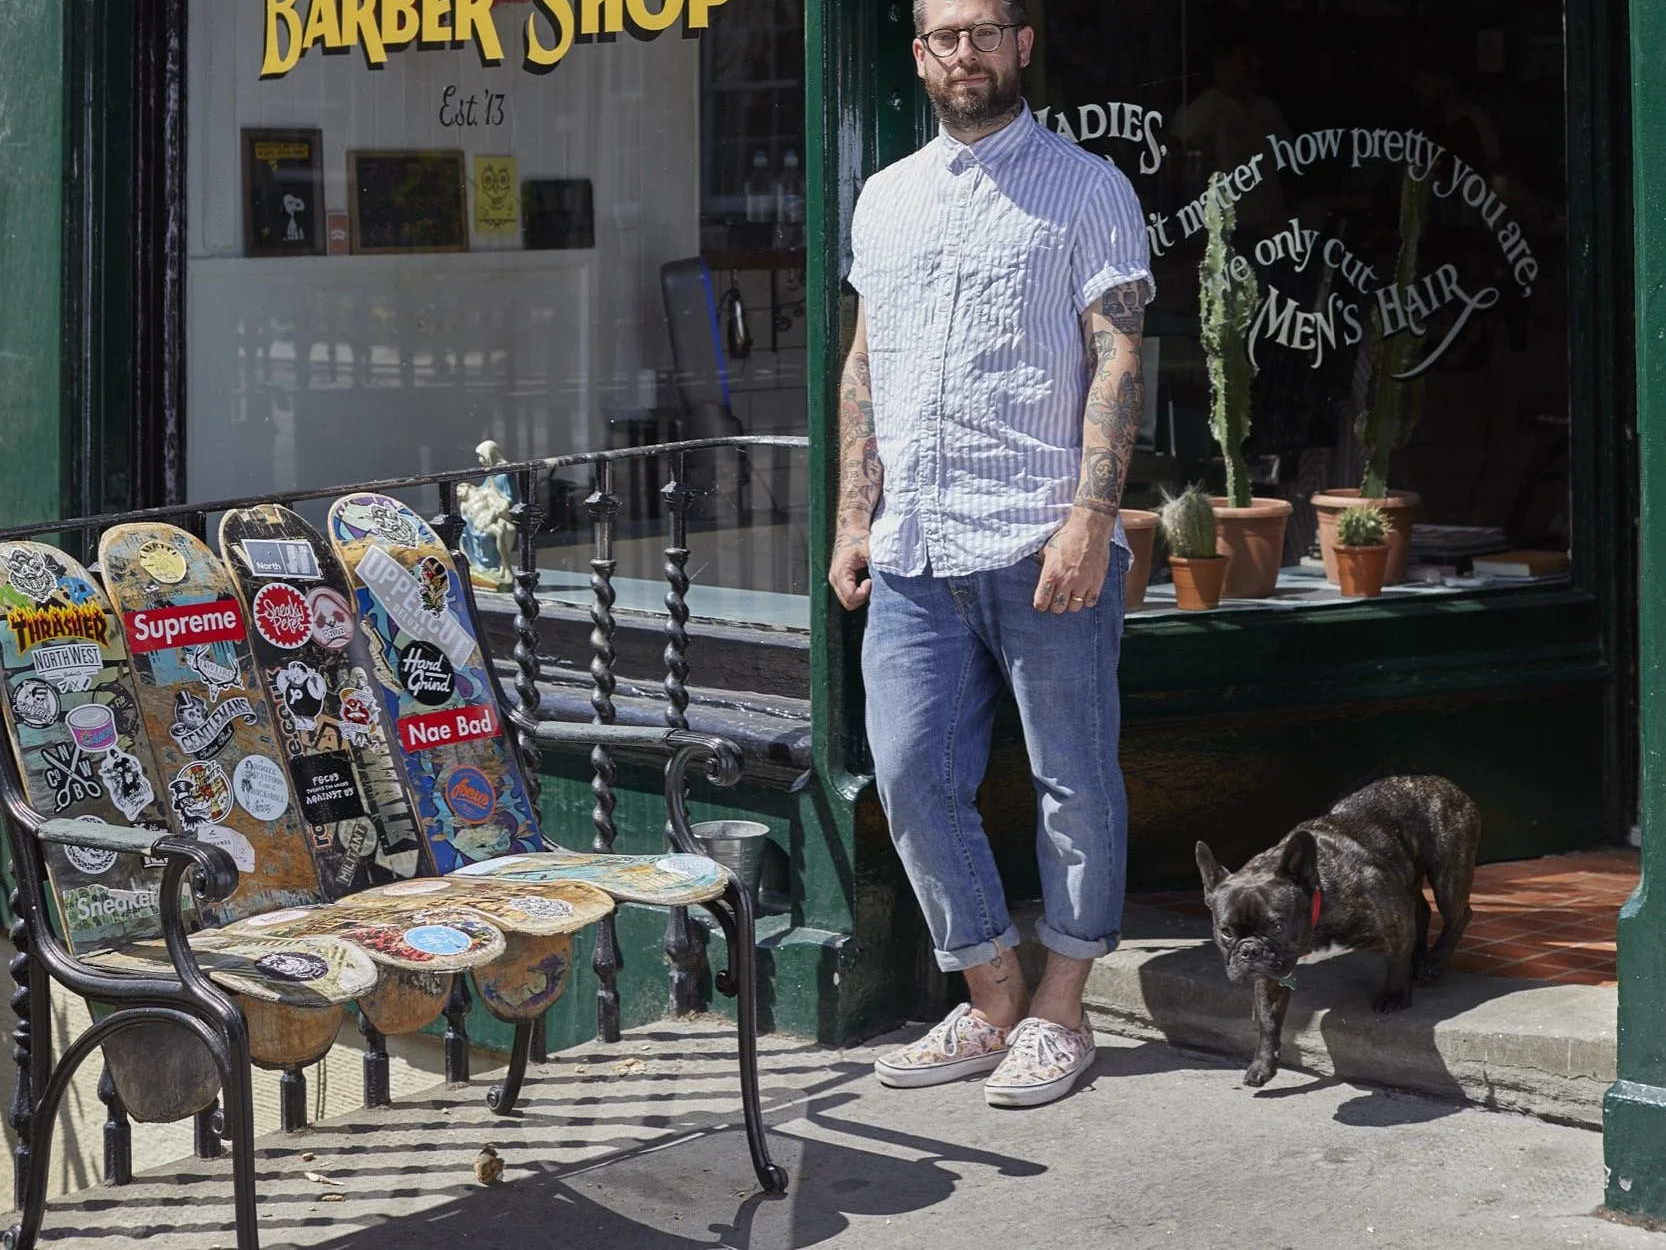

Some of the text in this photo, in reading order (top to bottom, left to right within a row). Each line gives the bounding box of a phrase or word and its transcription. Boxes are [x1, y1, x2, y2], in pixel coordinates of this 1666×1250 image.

[1176, 153, 1264, 239] matter
[1267, 128, 1346, 176] how
[1350, 126, 1445, 181] pretty
[1432, 154, 1510, 232] you
[1498, 220, 1541, 298] are,
[1255, 218, 1321, 273] only
[1322, 237, 1380, 295] cut
[1247, 262, 1499, 381] MEN'S HAIR
[256, 561, 282, 570] North
[259, 595, 305, 622] Sneaky
[8, 601, 112, 657] THRASHER
[134, 611, 237, 644] Supreme
[402, 647, 443, 672] Hard
[407, 671, 451, 697] Grind
[180, 697, 252, 752] GENTLEMANS
[408, 709, 493, 745] Nae Bad
[306, 789, 343, 805] AGAINST
[343, 787, 354, 797] US
[312, 772, 340, 786] FOCUS
[338, 825, 368, 883] MILITANT
